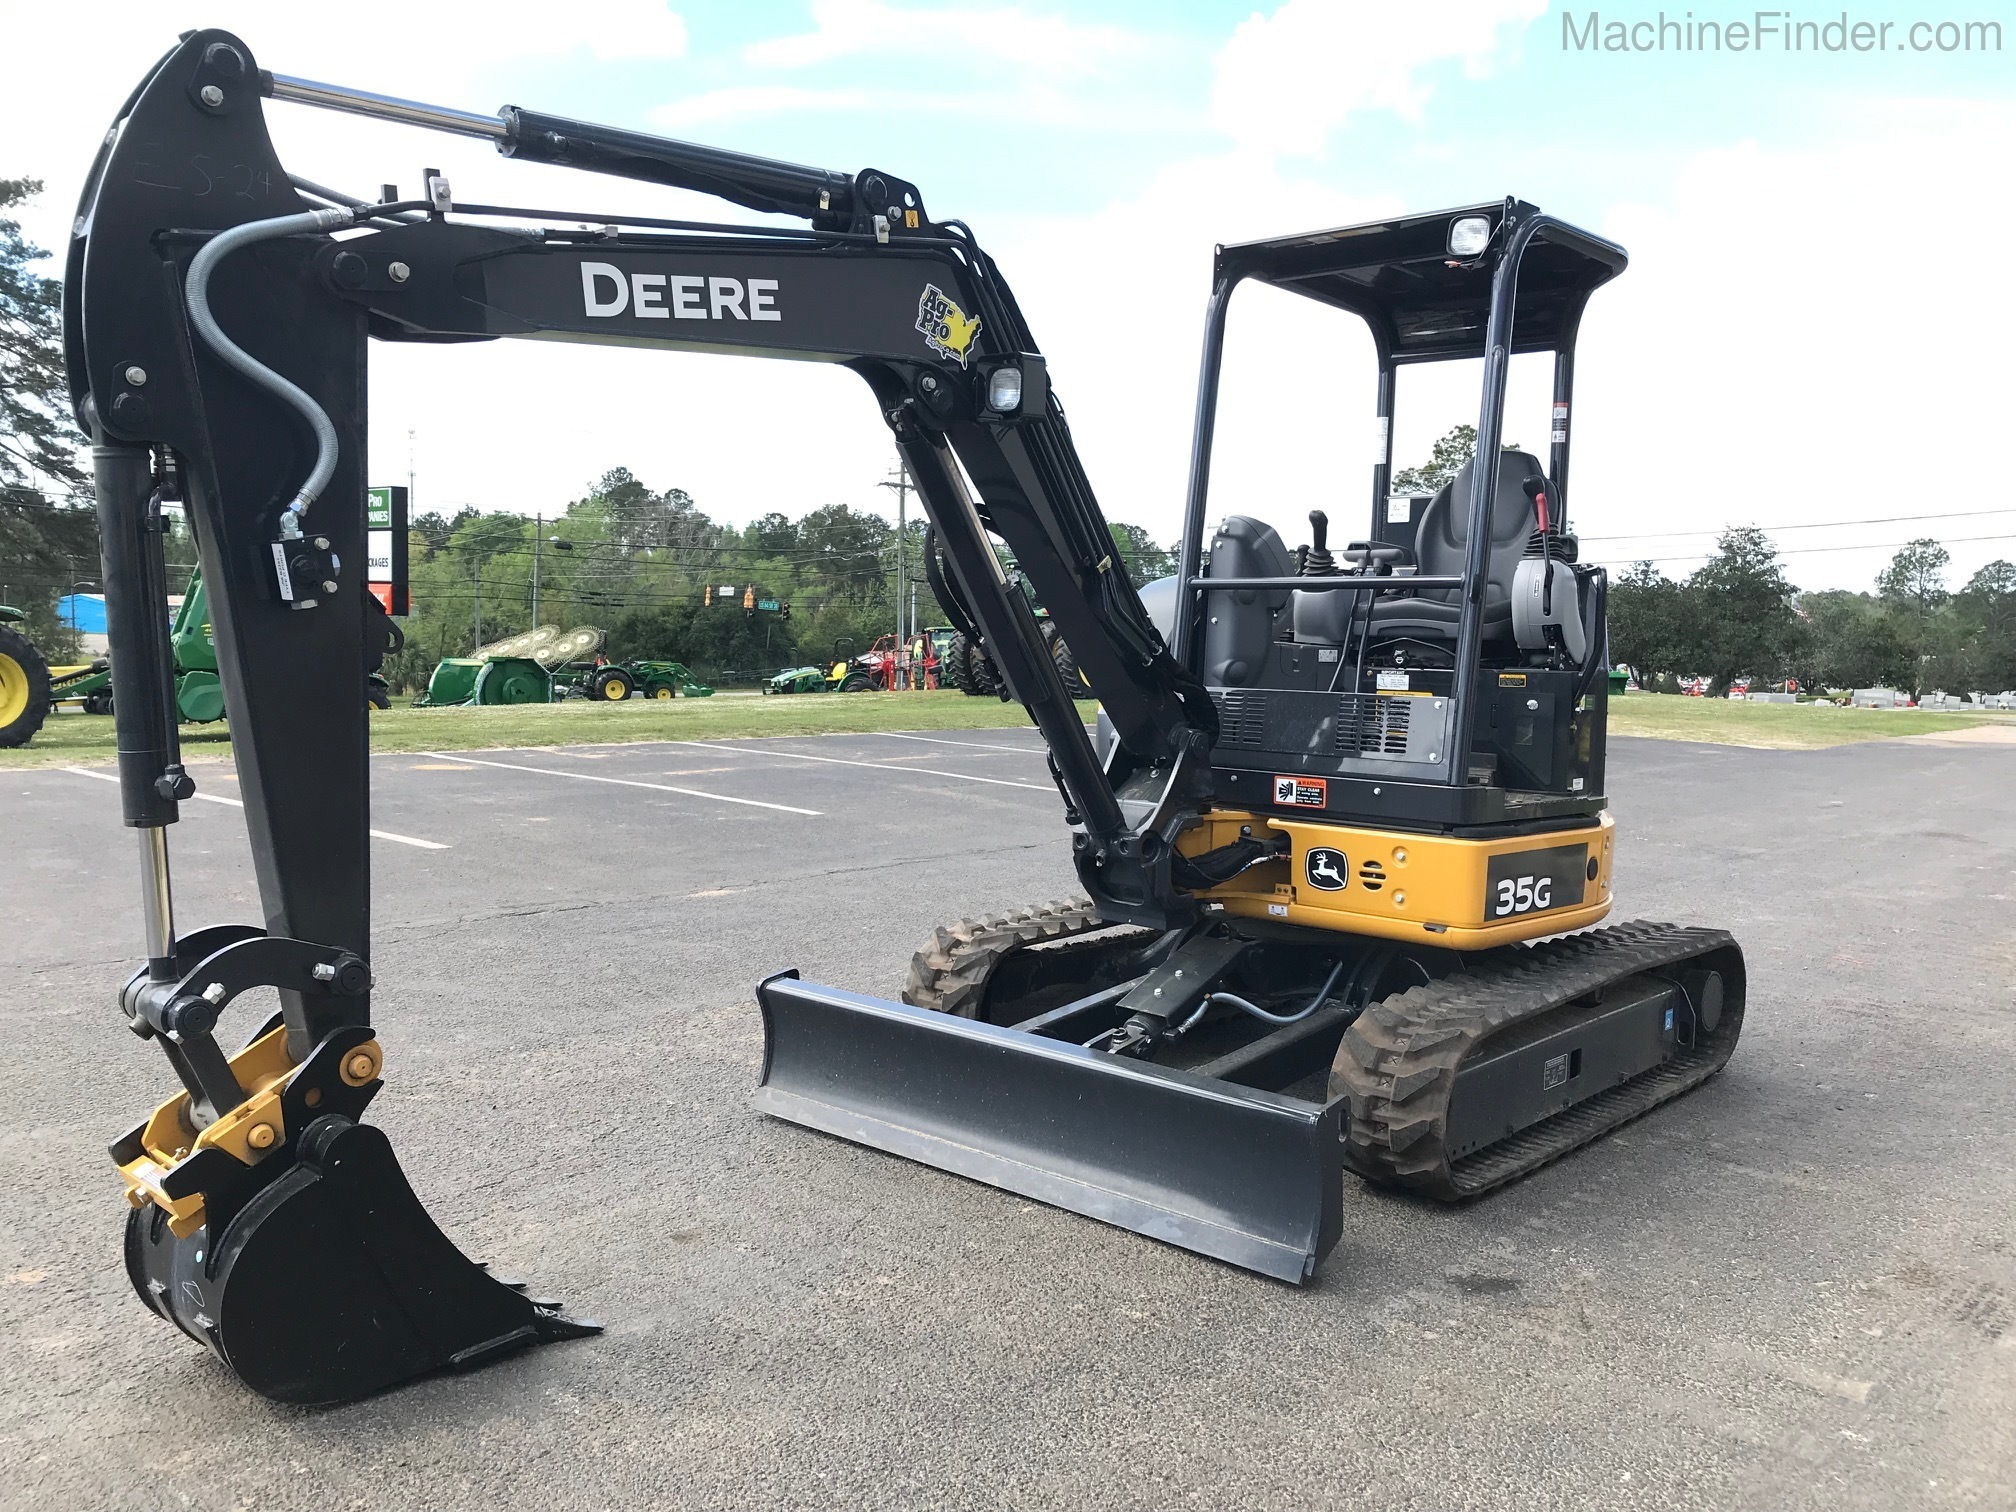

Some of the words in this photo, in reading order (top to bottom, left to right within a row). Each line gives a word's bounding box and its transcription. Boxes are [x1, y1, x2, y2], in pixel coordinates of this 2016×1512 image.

[580, 261, 781, 321] DEERE
[922, 289, 955, 321] Ag-
[918, 308, 951, 340] Pro
[1495, 875, 1552, 915] 35G
